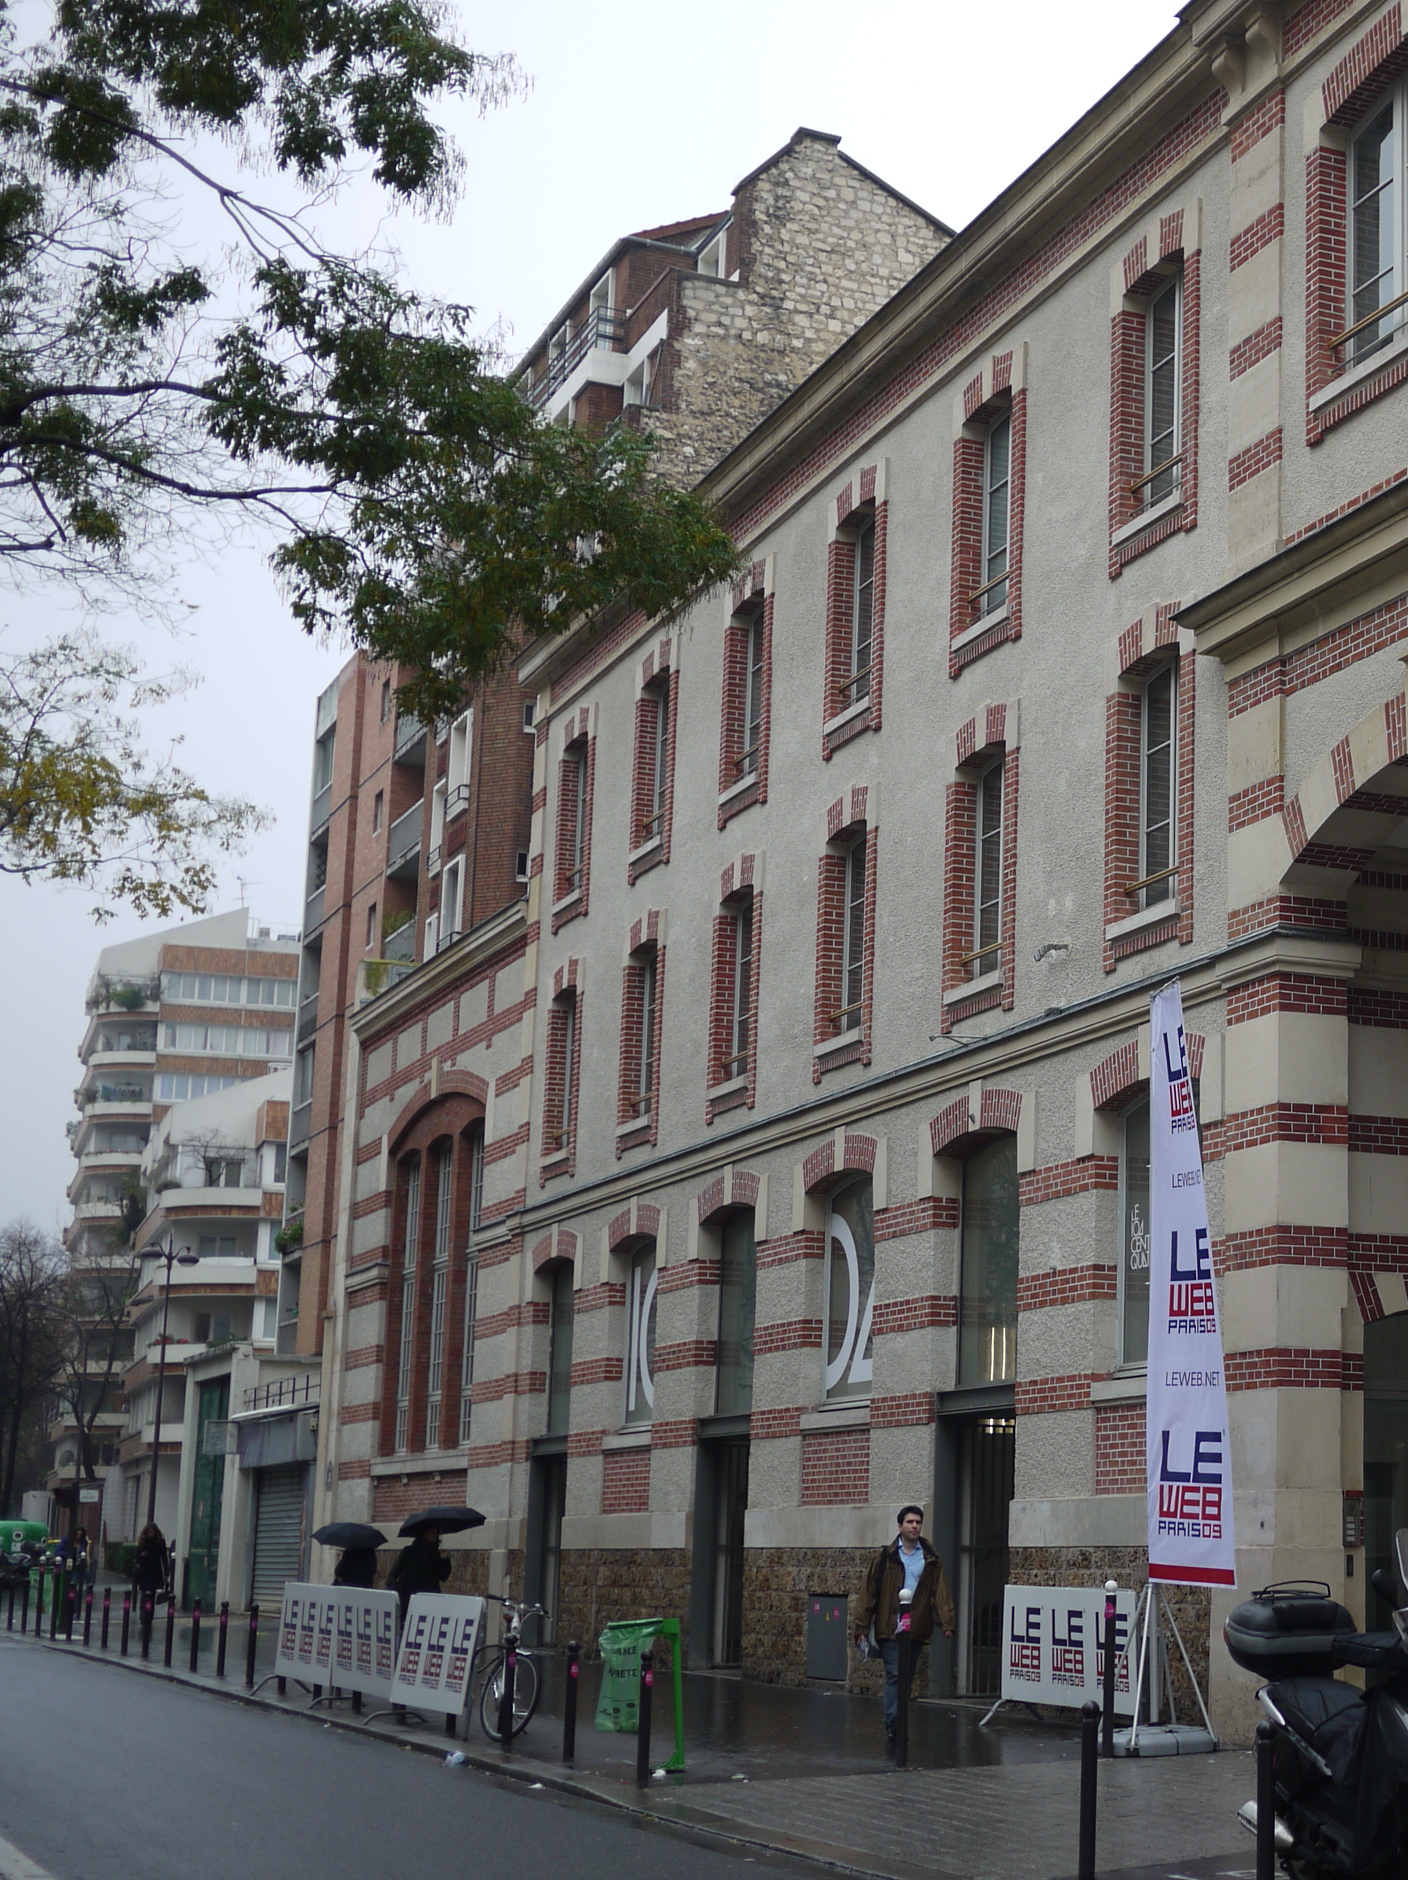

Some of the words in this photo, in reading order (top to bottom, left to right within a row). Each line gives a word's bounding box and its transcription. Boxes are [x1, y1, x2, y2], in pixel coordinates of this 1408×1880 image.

[1131, 1204, 1139, 1220] LE
[1170, 1228, 1211, 1282] LE
[1169, 1282, 1214, 1317] WEB
[1168, 1318, 1216, 1334] PARIS09
[1165, 1372, 1220, 1387] LEWEB.NET
[1160, 1430, 1222, 1484] LE
[1159, 1484, 1222, 1521] WEB
[1158, 1520, 1222, 1539] PARIS09
[284, 1599, 299, 1630] LE
[301, 1601, 316, 1633] LE
[319, 1603, 334, 1636] LE
[338, 1604, 352, 1638] LE
[357, 1607, 371, 1641] LE
[376, 1610, 391, 1645] LE
[1011, 1606, 1041, 1644] LE
[1052, 1608, 1083, 1648] LE
[1095, 1611, 1128, 1652] LE
[405, 1614, 427, 1650] LE
[427, 1616, 449, 1653] LE
[451, 1618, 474, 1655] LE
[1010, 1644, 1041, 1670] WEB
[1052, 1648, 1084, 1674] WEB
[1096, 1651, 1129, 1680] WB
[1010, 1669, 1041, 1682] PARIS09
[1052, 1673, 1085, 1688] PARIS09
